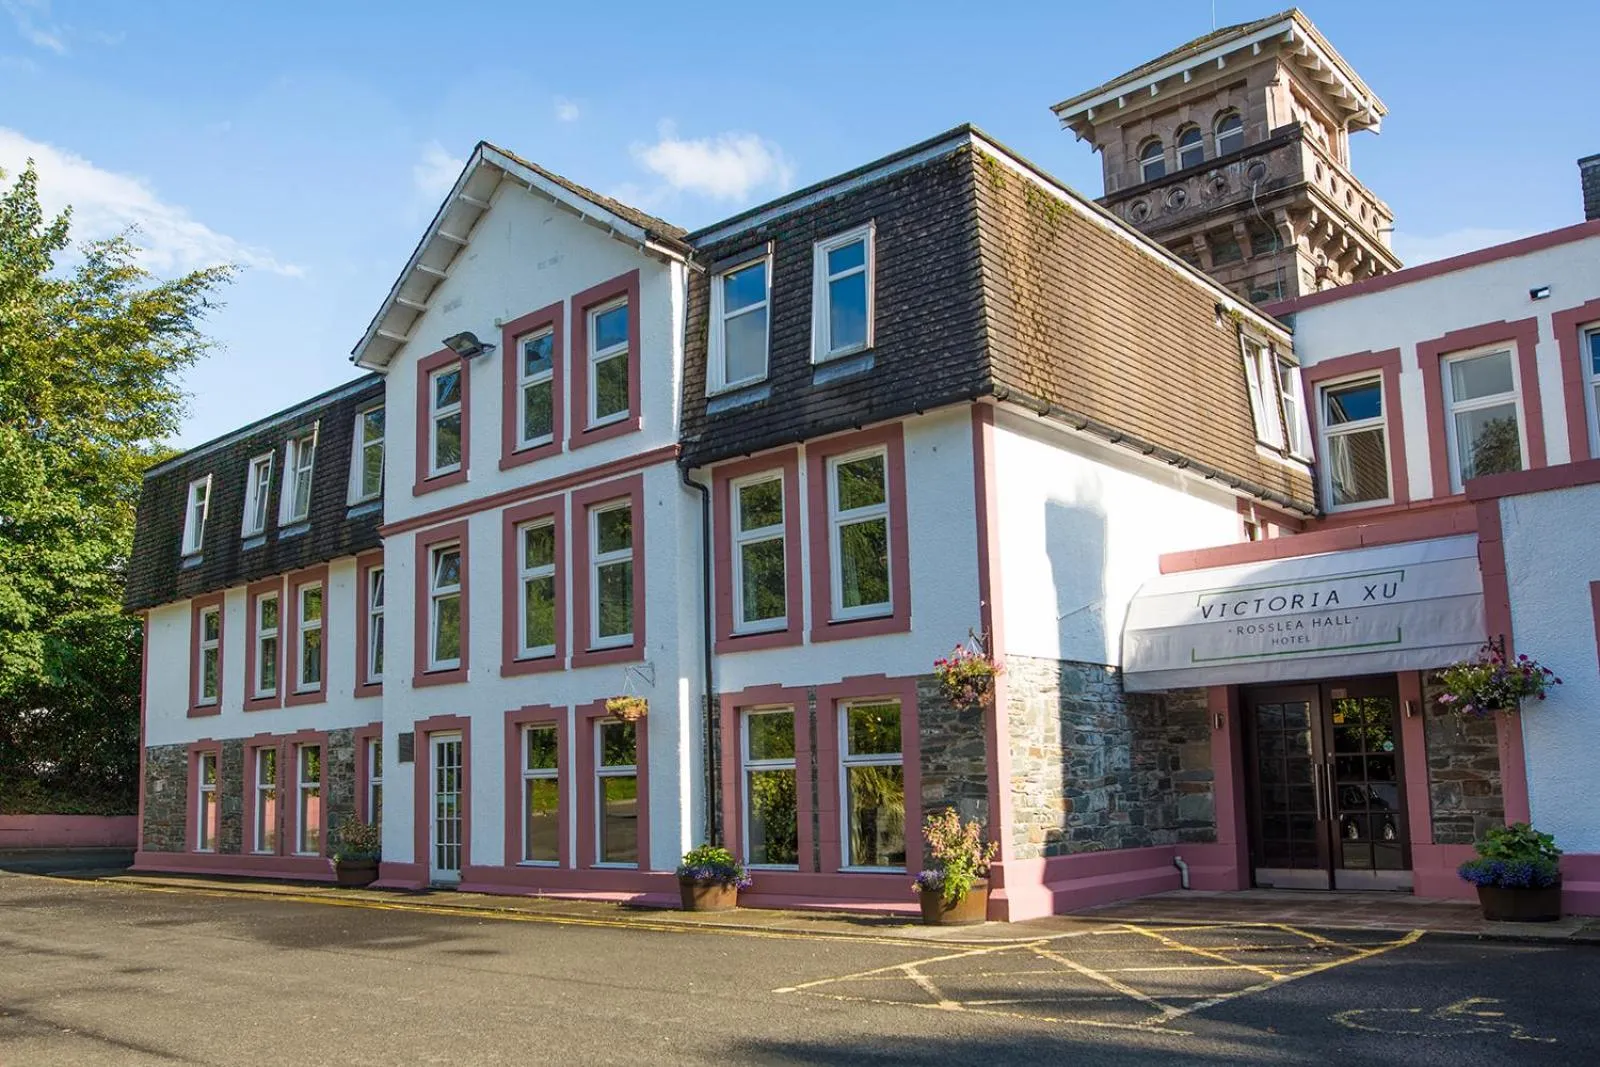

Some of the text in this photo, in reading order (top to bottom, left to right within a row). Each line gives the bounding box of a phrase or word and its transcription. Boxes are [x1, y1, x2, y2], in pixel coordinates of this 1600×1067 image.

[1201, 582, 1398, 619] VICTORIA XU
[1236, 615, 1352, 636] ROSSLEA HALL
[1272, 635, 1311, 646] HOTEL
